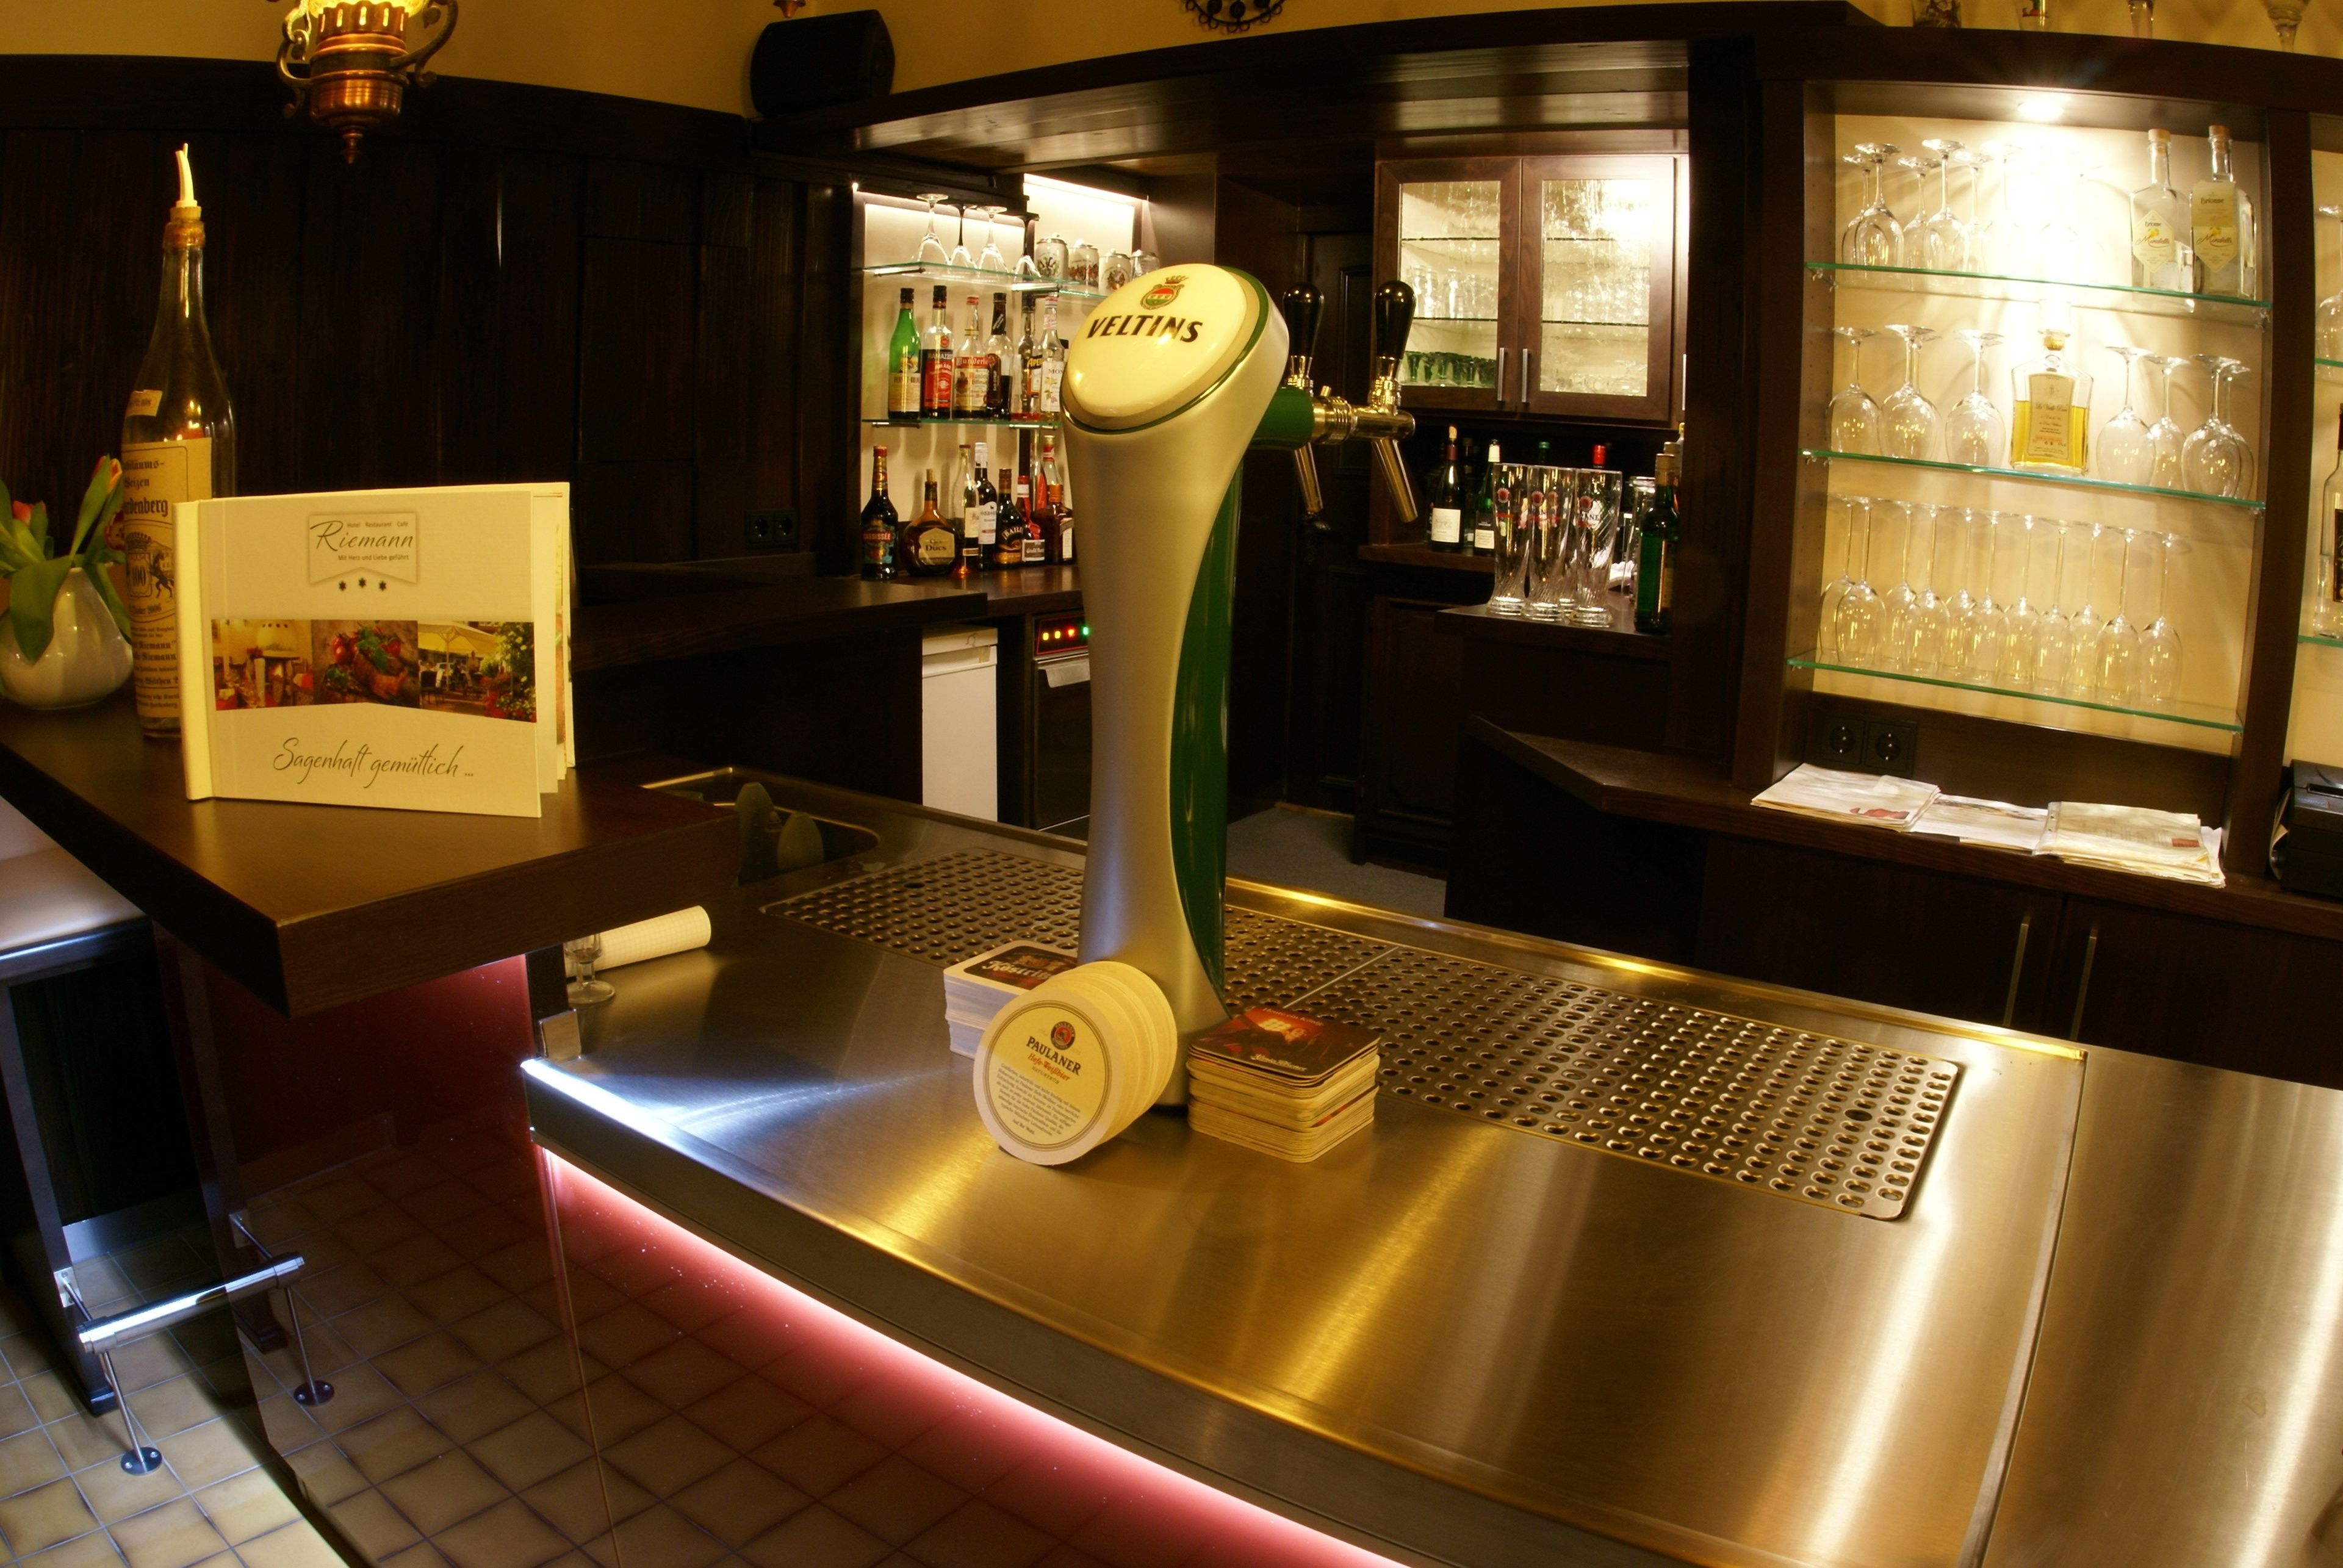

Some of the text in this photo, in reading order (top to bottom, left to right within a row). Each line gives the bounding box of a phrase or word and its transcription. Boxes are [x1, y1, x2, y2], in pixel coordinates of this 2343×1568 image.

[1087, 314, 1203, 343] VELTINS
[309, 520, 414, 552] Riemann
[273, 737, 372, 785] Sagenhaft
[363, 743, 464, 789] gemütlich
[1026, 1035, 1082, 1076] PAULANER
